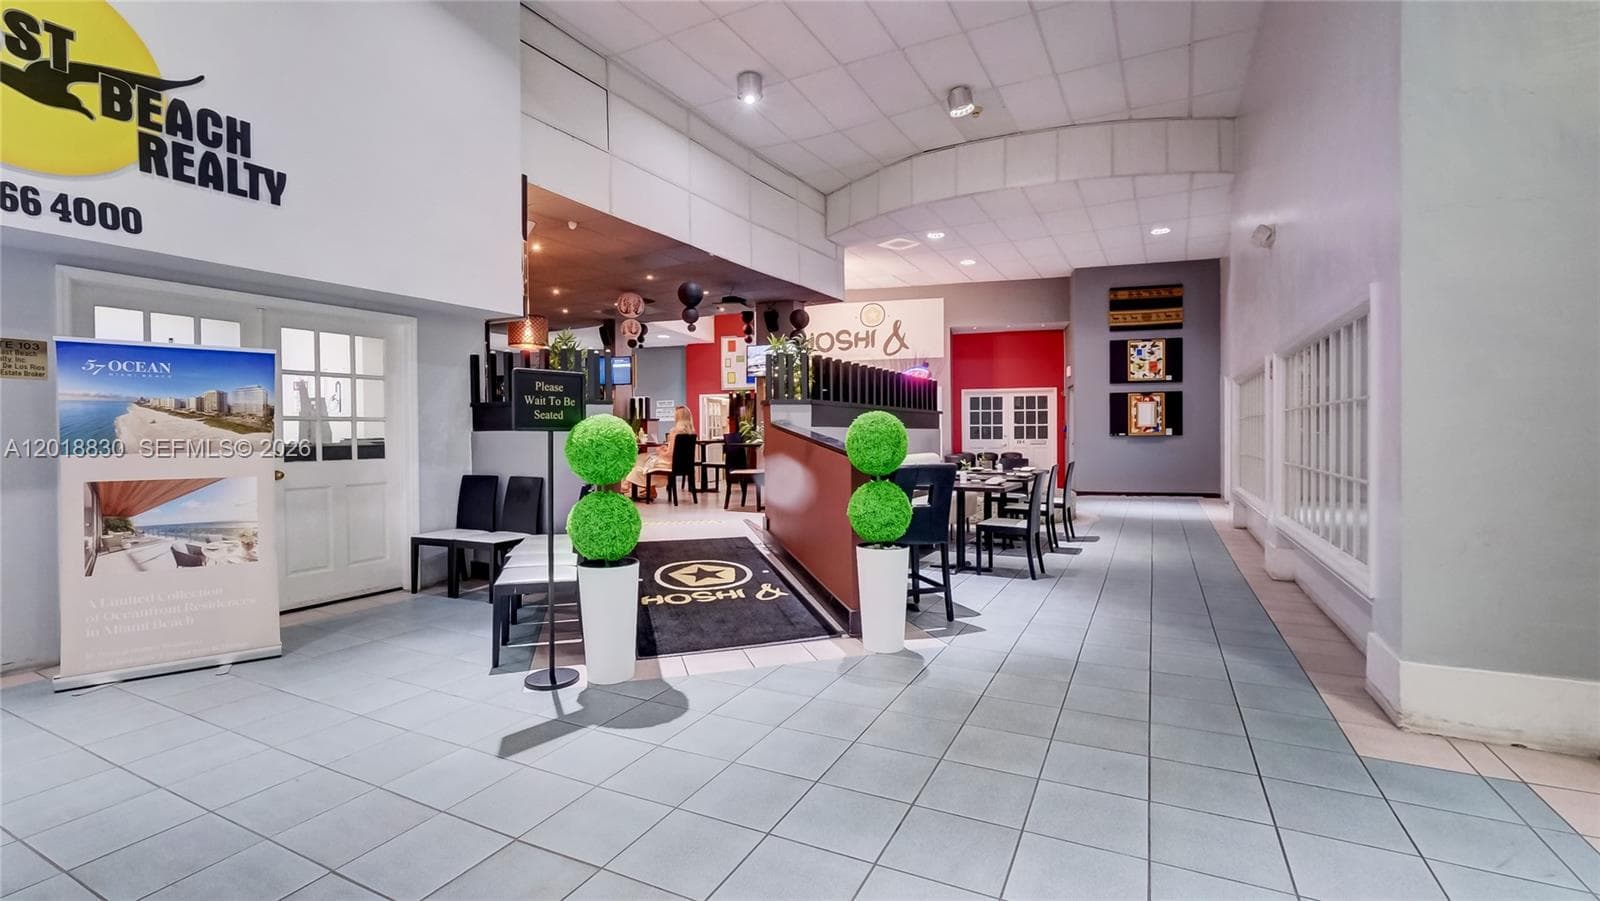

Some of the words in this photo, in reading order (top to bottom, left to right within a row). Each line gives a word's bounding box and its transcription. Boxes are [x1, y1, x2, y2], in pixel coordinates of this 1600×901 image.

[99, 73, 251, 159] BEACH
[138, 131, 286, 206] REALTY
[50, 193, 143, 234] 4000
[19, 342, 40, 351] 103
[883, 319, 910, 356] &
[81, 359, 105, 376] 57
[108, 360, 172, 374] OCEAN
[535, 381, 564, 392] Please
[524, 395, 546, 406] Wait
[548, 396, 561, 406] To
[563, 397, 576, 407] Be
[534, 410, 564, 420] Seated
[88, 599, 97, 609] A
[99, 592, 155, 607] Limited
[158, 585, 224, 602] Collection
[640, 588, 745, 606] HOSHI
[755, 583, 789, 601] &
[84, 612, 99, 624] of
[103, 603, 182, 621] Oceanfront
[184, 595, 257, 613] Residences
[84, 627, 101, 639] in
[104, 622, 150, 636] Miami
[153, 617, 196, 631] Beach
